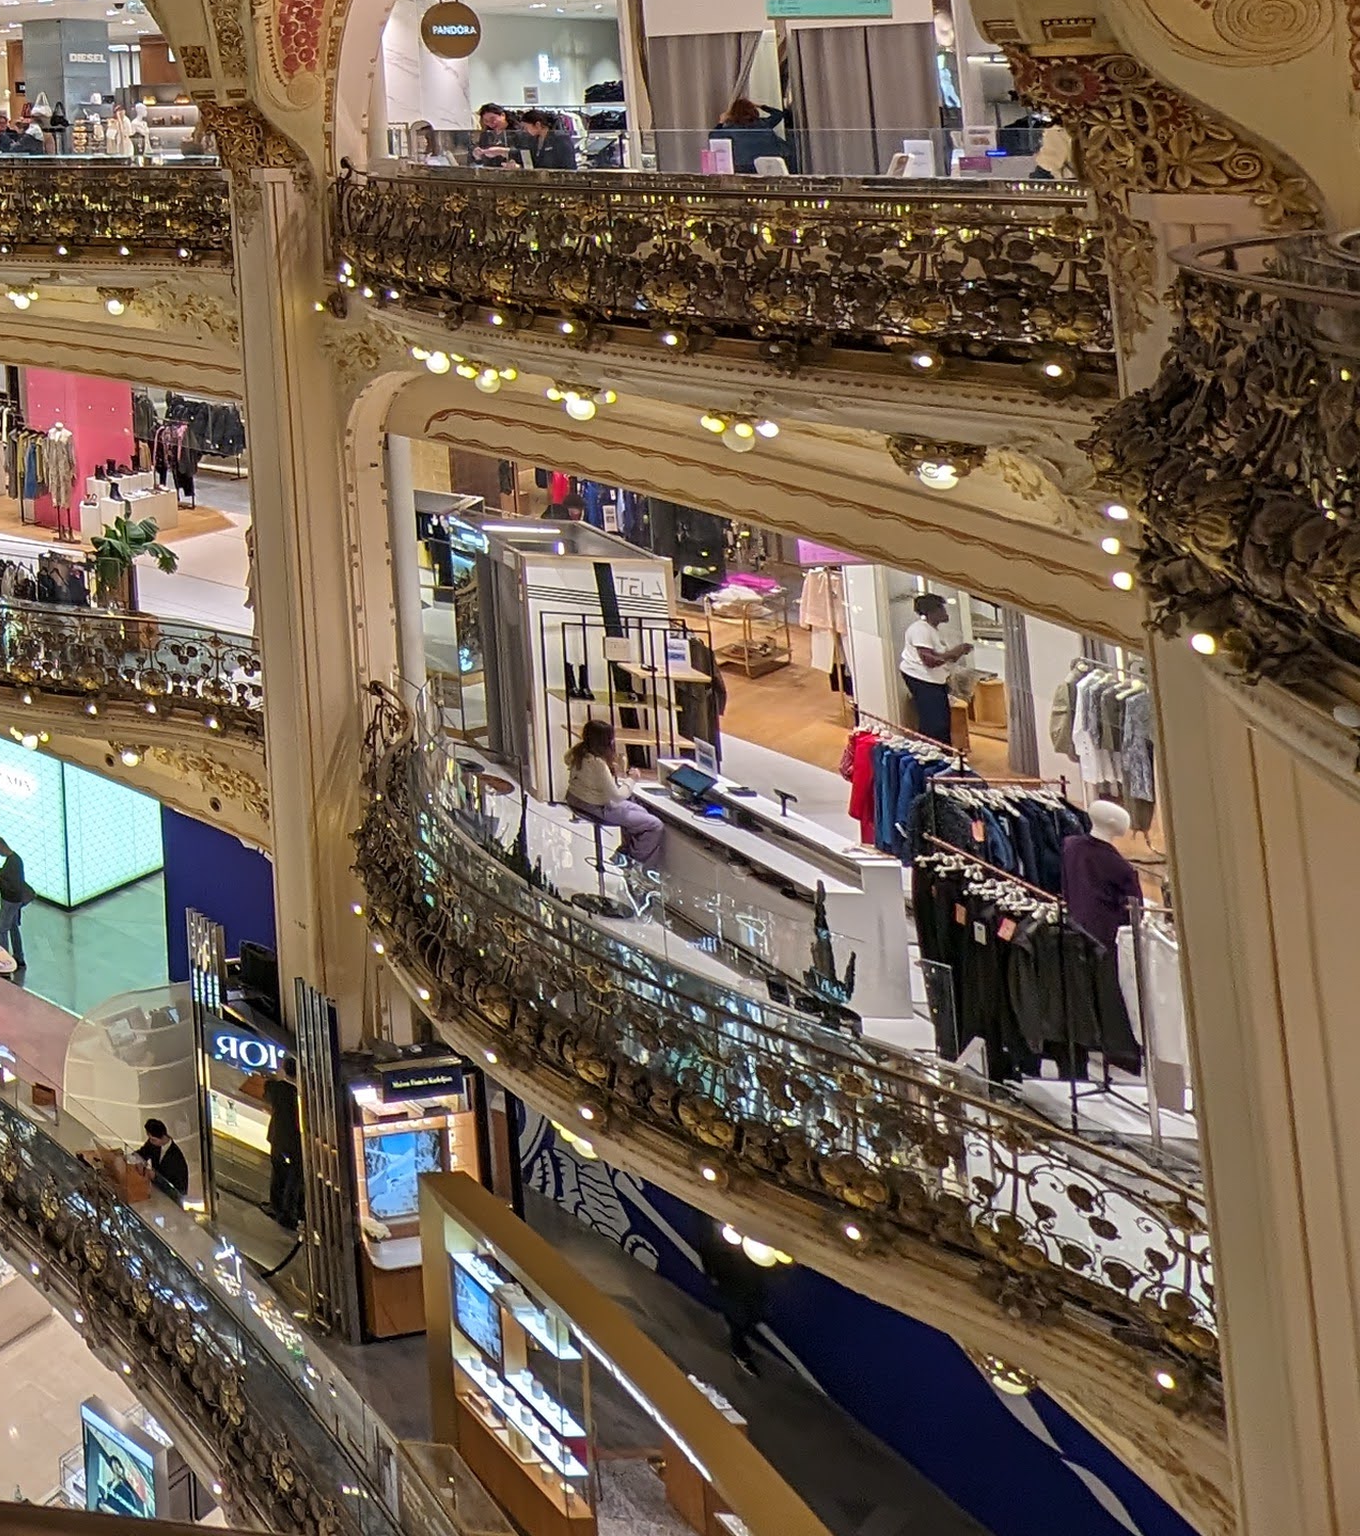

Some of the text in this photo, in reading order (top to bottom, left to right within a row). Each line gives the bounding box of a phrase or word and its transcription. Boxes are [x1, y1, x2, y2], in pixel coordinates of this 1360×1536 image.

[432, 25, 478, 35] PANDORA
[68, 52, 107, 64] DIESEL
[615, 576, 665, 599] TELA
